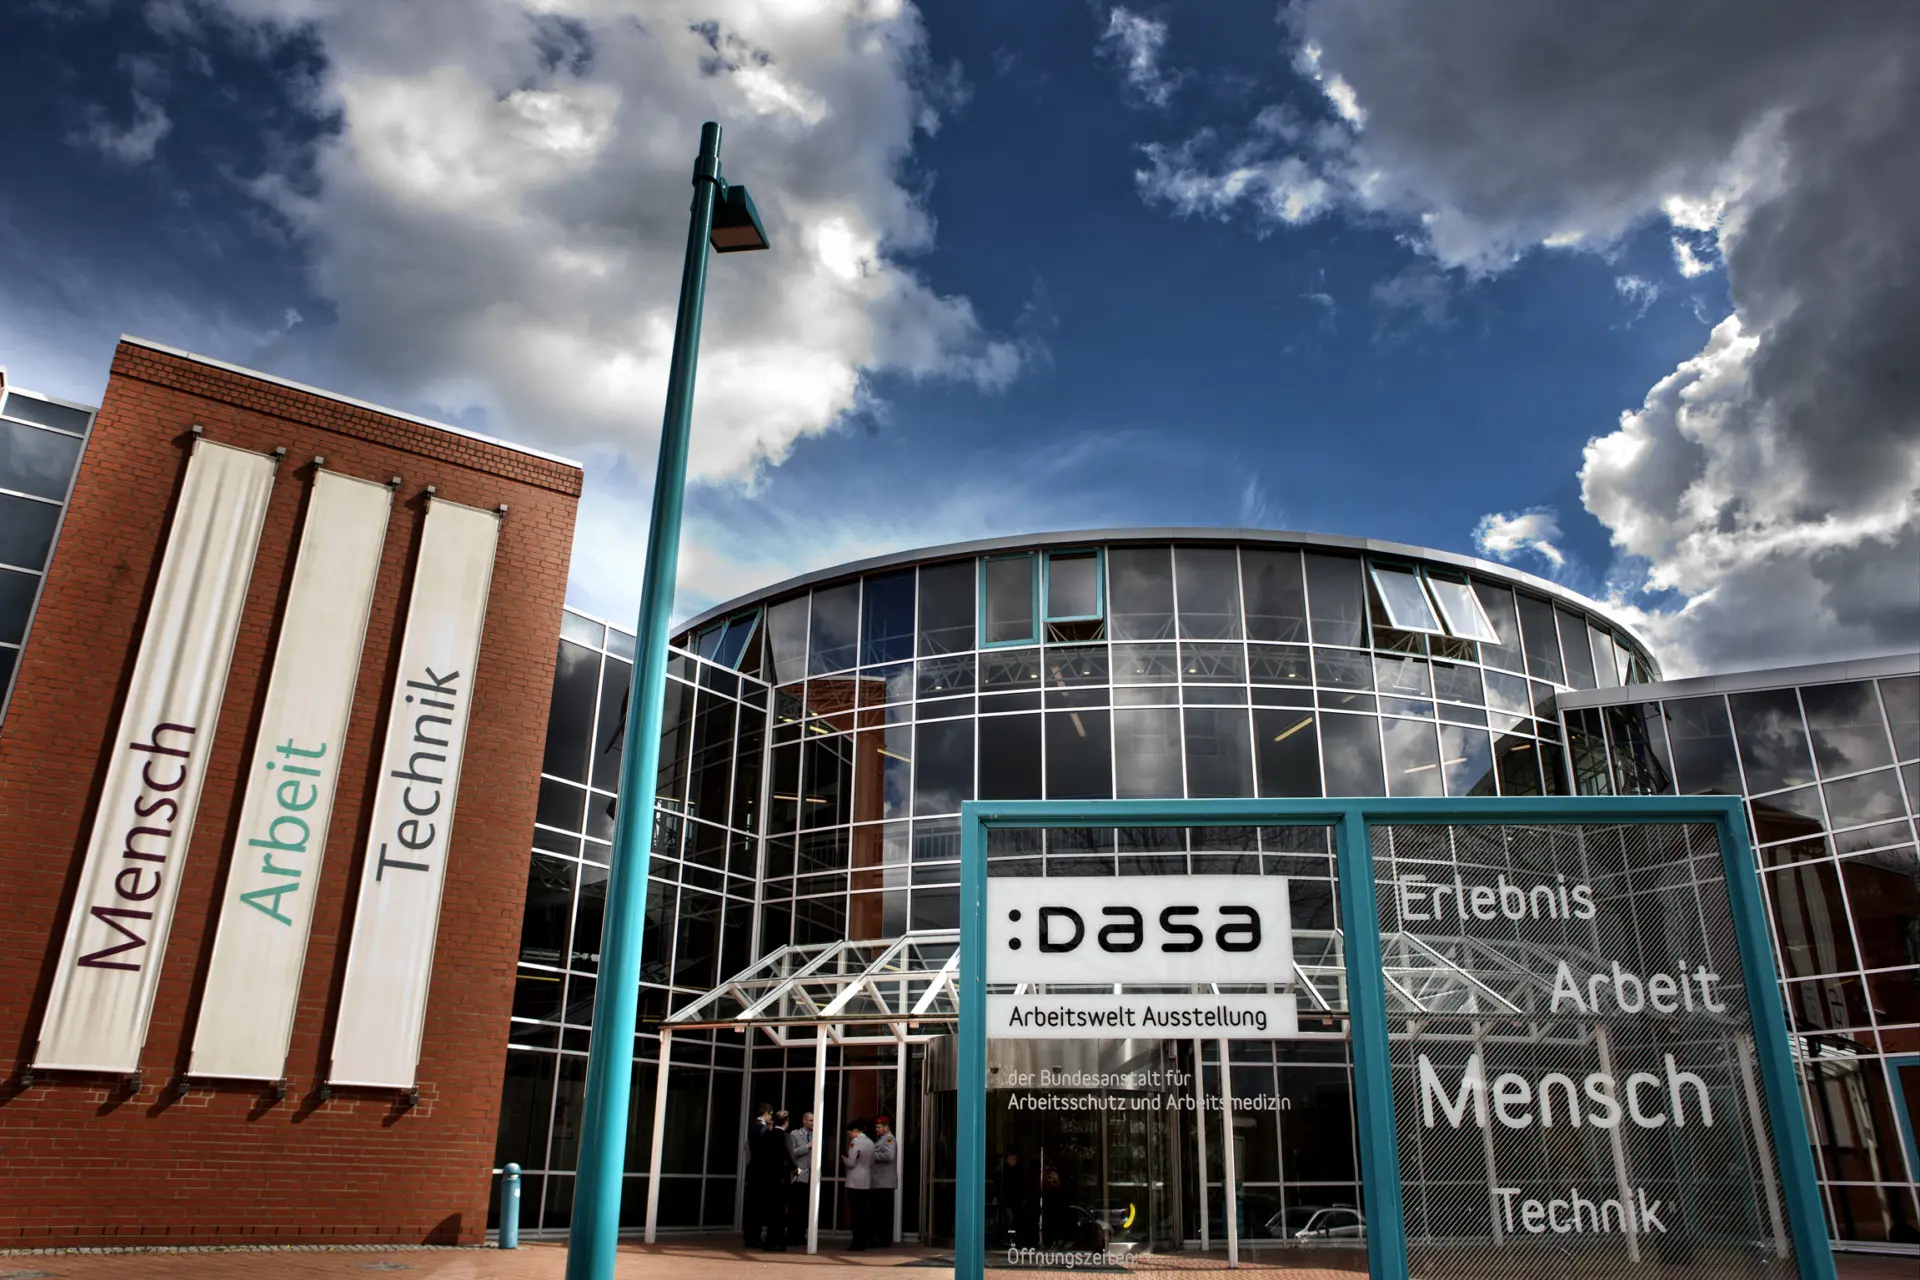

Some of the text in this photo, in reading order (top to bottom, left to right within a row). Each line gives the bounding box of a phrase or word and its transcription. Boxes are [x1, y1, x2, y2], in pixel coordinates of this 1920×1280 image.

[376, 666, 460, 882] Technik
[77, 721, 197, 972] Mensch
[240, 738, 328, 927] Arbeit
[1399, 874, 1597, 921] Erlebnis
[1549, 959, 1726, 1014] Arbeit
[1009, 1006, 1268, 1031] Arbeitswelt Ausstellung
[1007, 1093, 1291, 1111] Arbeitsschutz und Arbeitsmedizin
[1008, 1069, 1192, 1087] der Bundesanstalt für
[1418, 1053, 1714, 1129] Mensch
[1491, 1187, 1667, 1234] Technik
